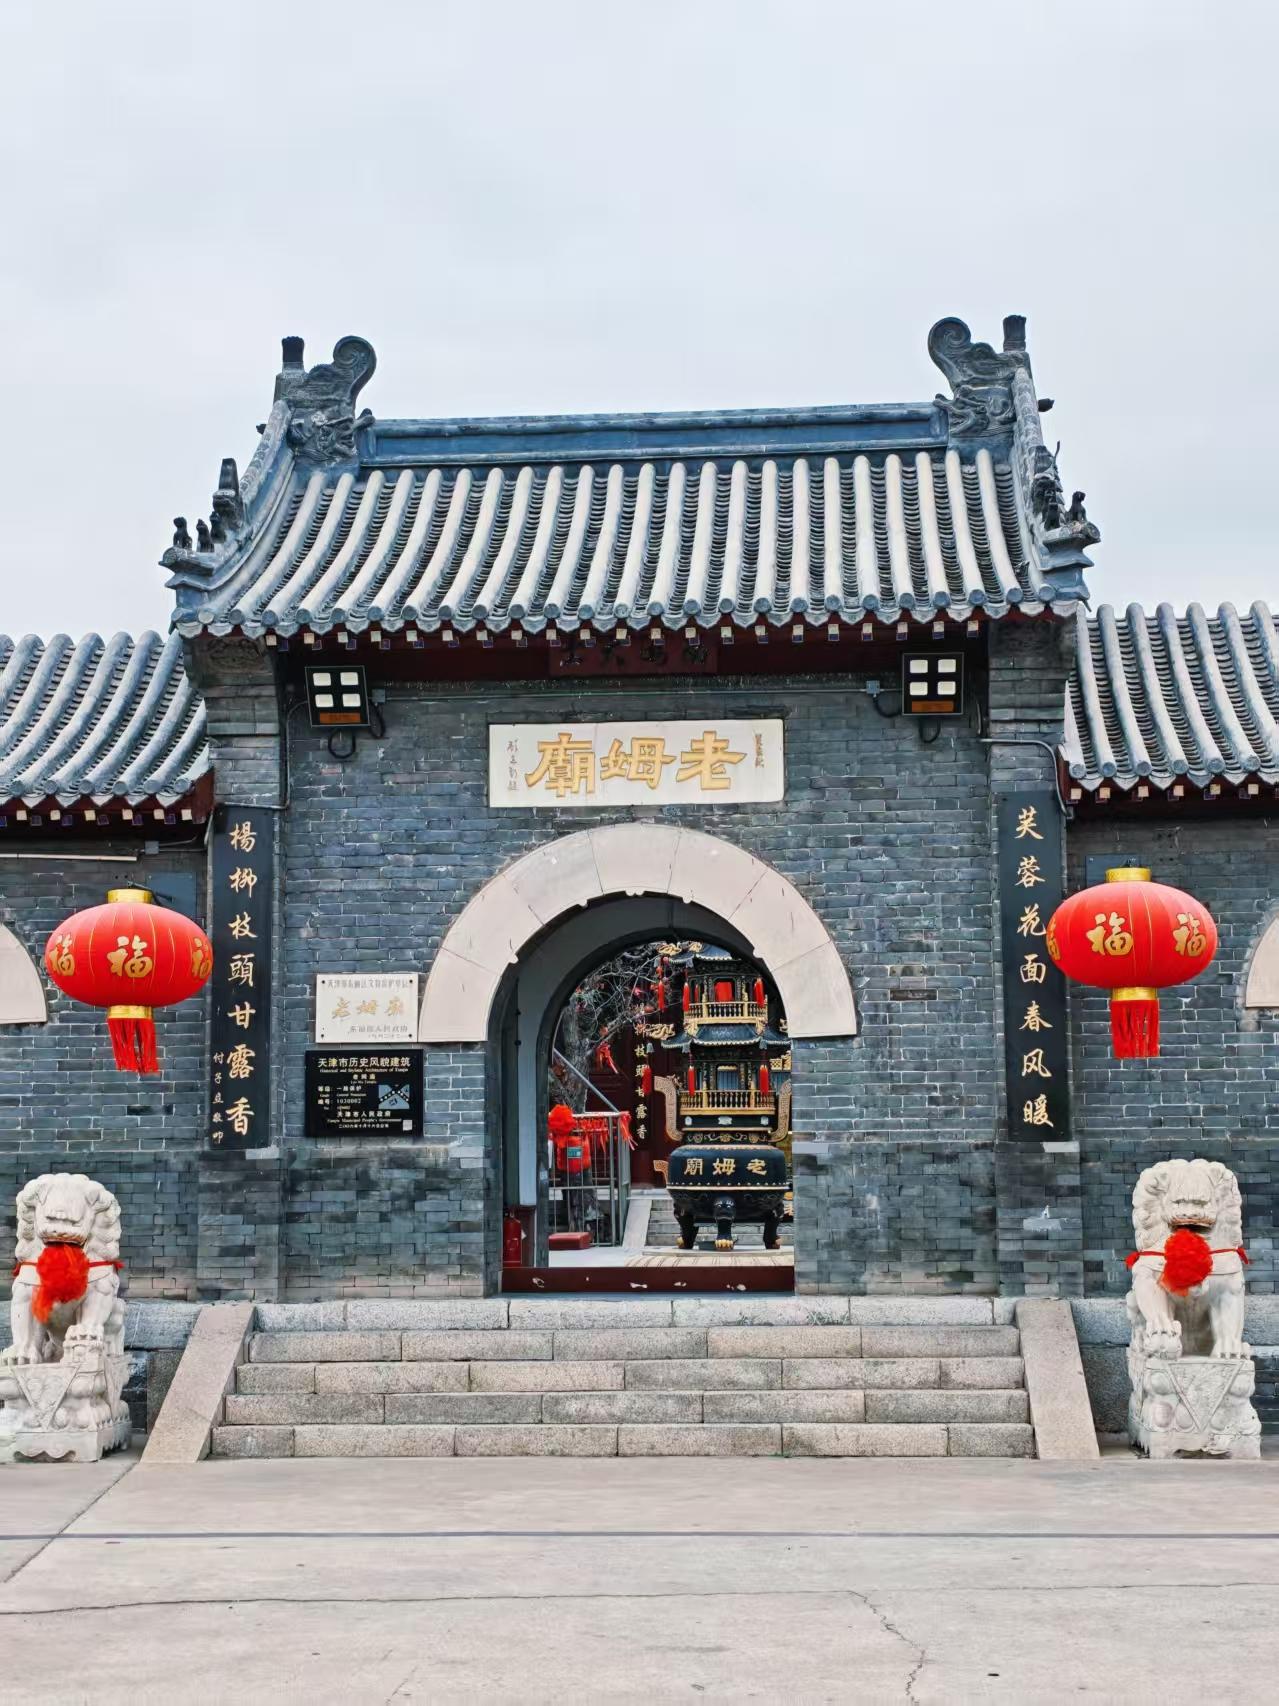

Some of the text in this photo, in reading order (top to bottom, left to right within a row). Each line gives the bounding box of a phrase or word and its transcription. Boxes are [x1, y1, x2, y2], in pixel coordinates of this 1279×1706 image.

[49, 933, 76, 976] 福
[1086, 912, 1134, 956] 福
[1173, 912, 1207, 957] 福
[107, 935, 153, 978] 福
[1014, 805, 1054, 1128] 芙蓉花面春风暖
[317, 1057, 411, 1068] 天津市历史风貌建筑
